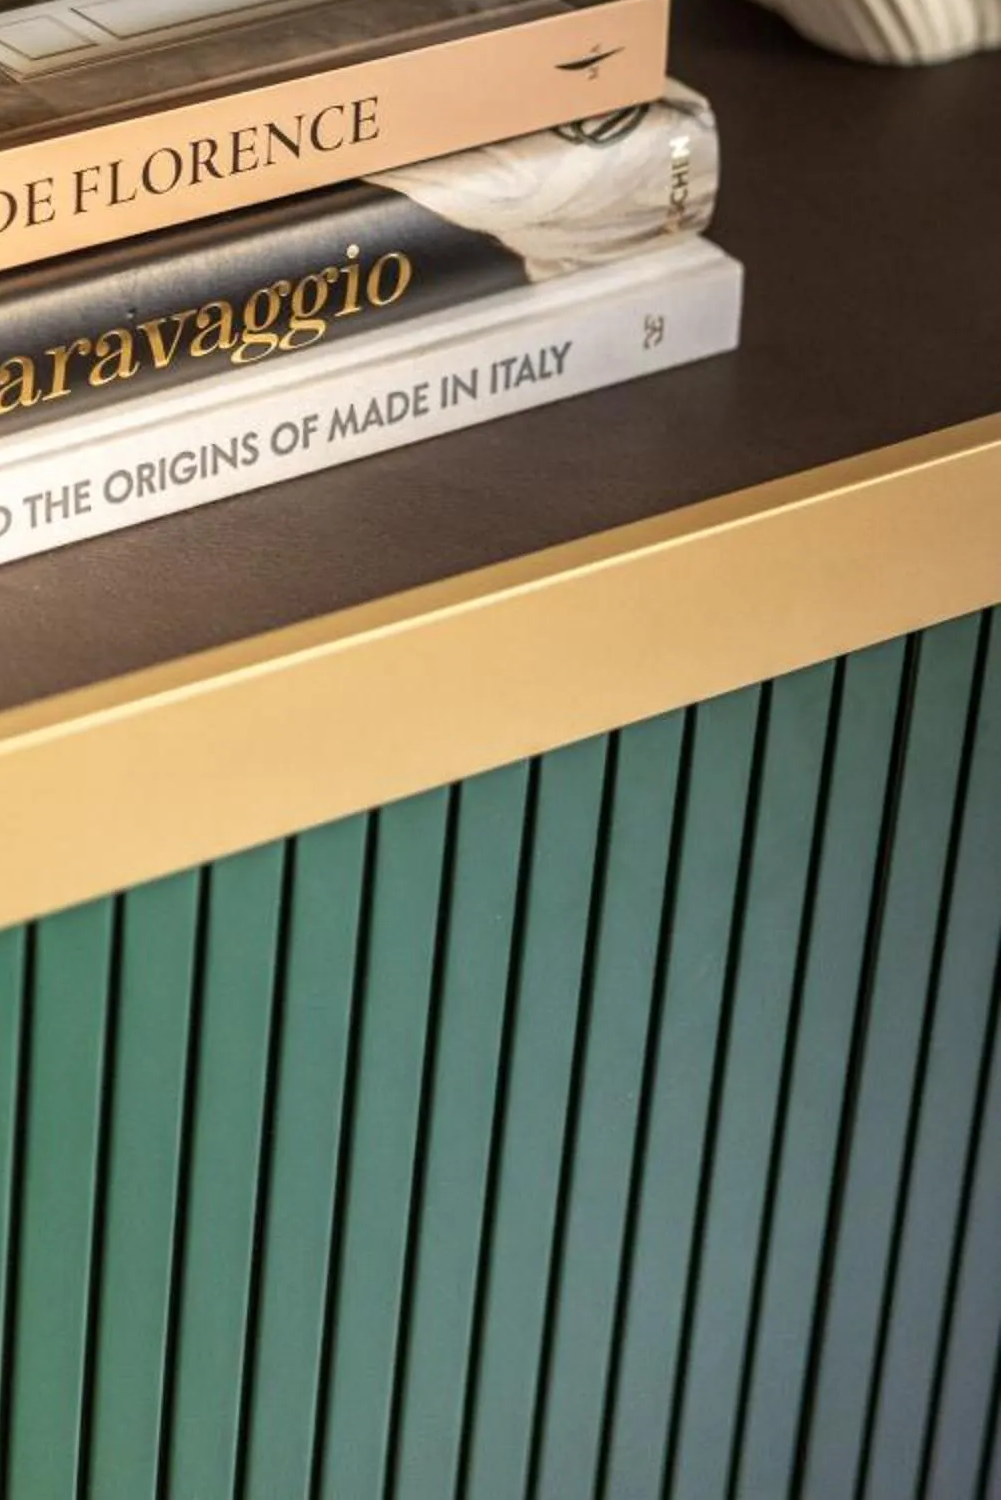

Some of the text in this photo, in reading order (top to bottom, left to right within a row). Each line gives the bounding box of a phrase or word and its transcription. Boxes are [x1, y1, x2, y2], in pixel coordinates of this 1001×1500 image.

[71, 96, 381, 217] FLORENCE
[22, 478, 93, 529] THE
[102, 431, 260, 503] ORIGINS
[270, 412, 320, 457] OF
[326, 383, 431, 442] MADE
[440, 367, 480, 411] IN
[488, 340, 574, 397] ITALY
